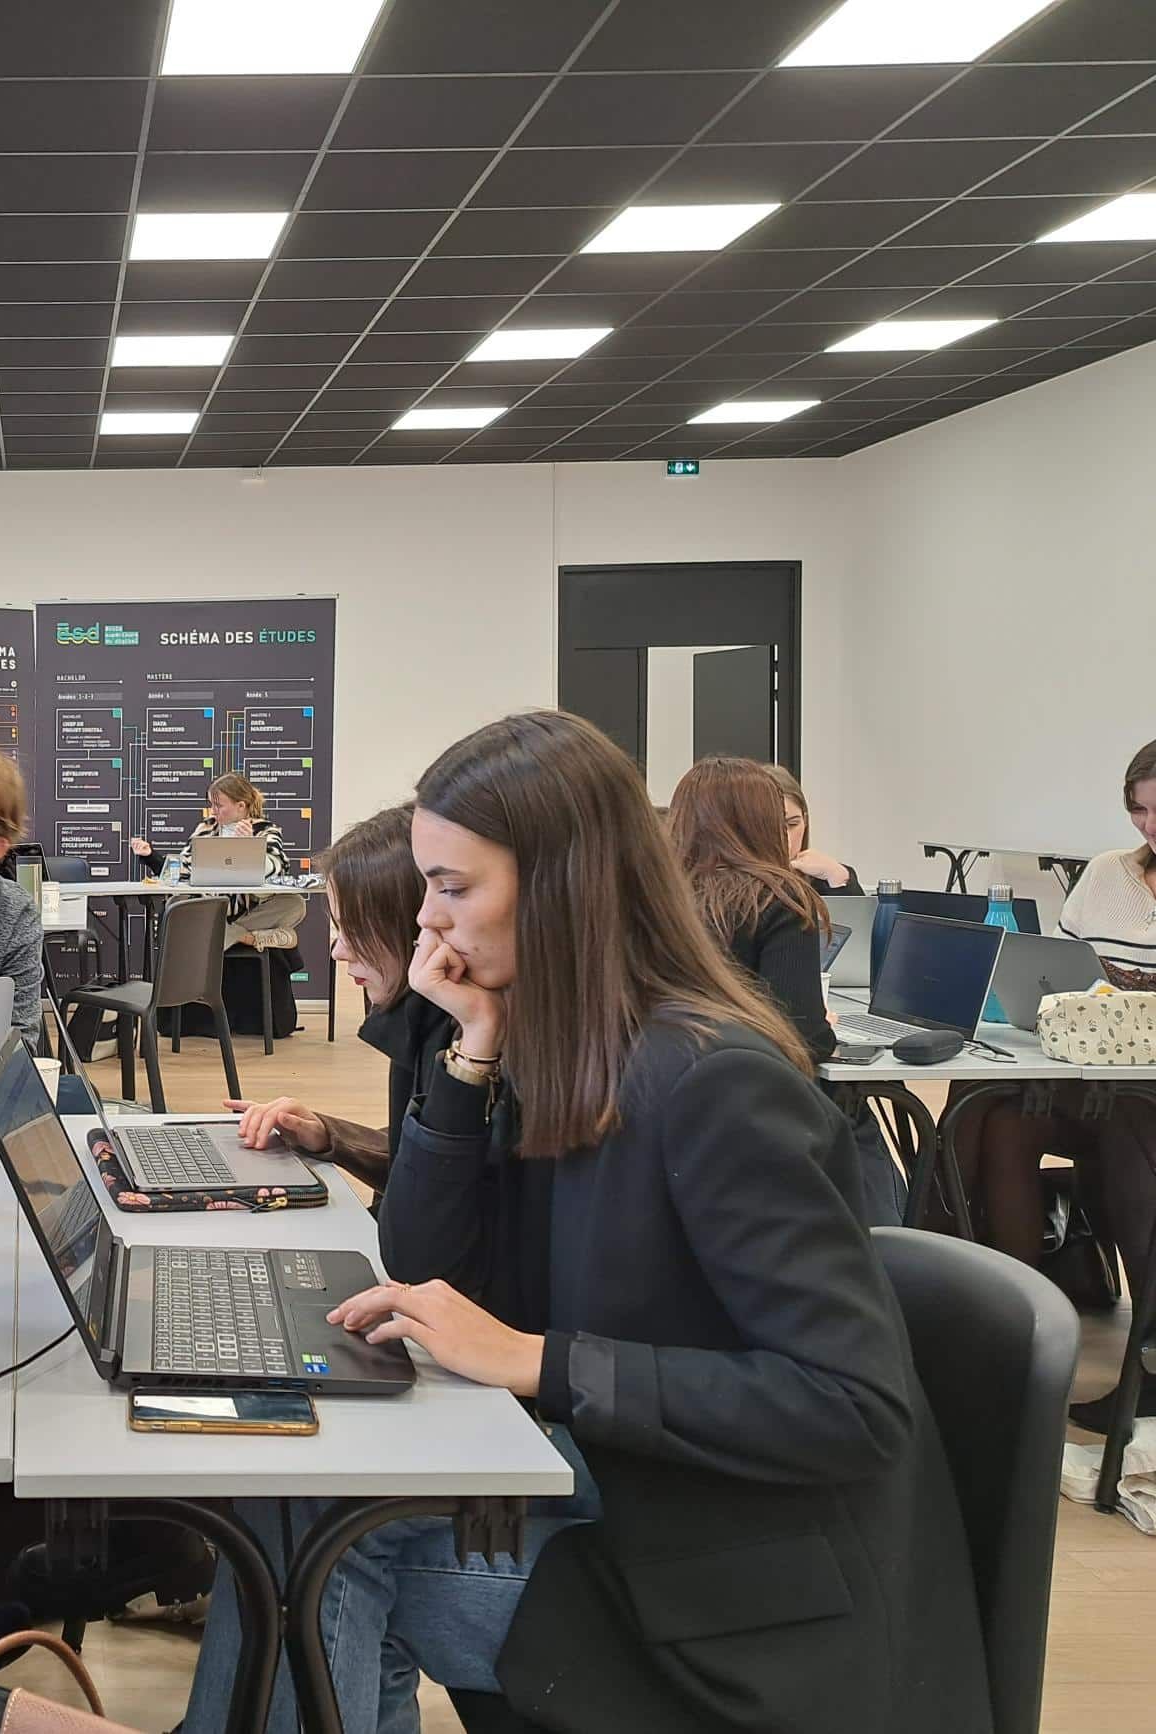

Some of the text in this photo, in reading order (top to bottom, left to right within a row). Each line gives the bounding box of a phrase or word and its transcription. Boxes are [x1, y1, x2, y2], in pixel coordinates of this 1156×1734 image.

[160, 628, 316, 645] SCHÉMA DES ÉTUDES
